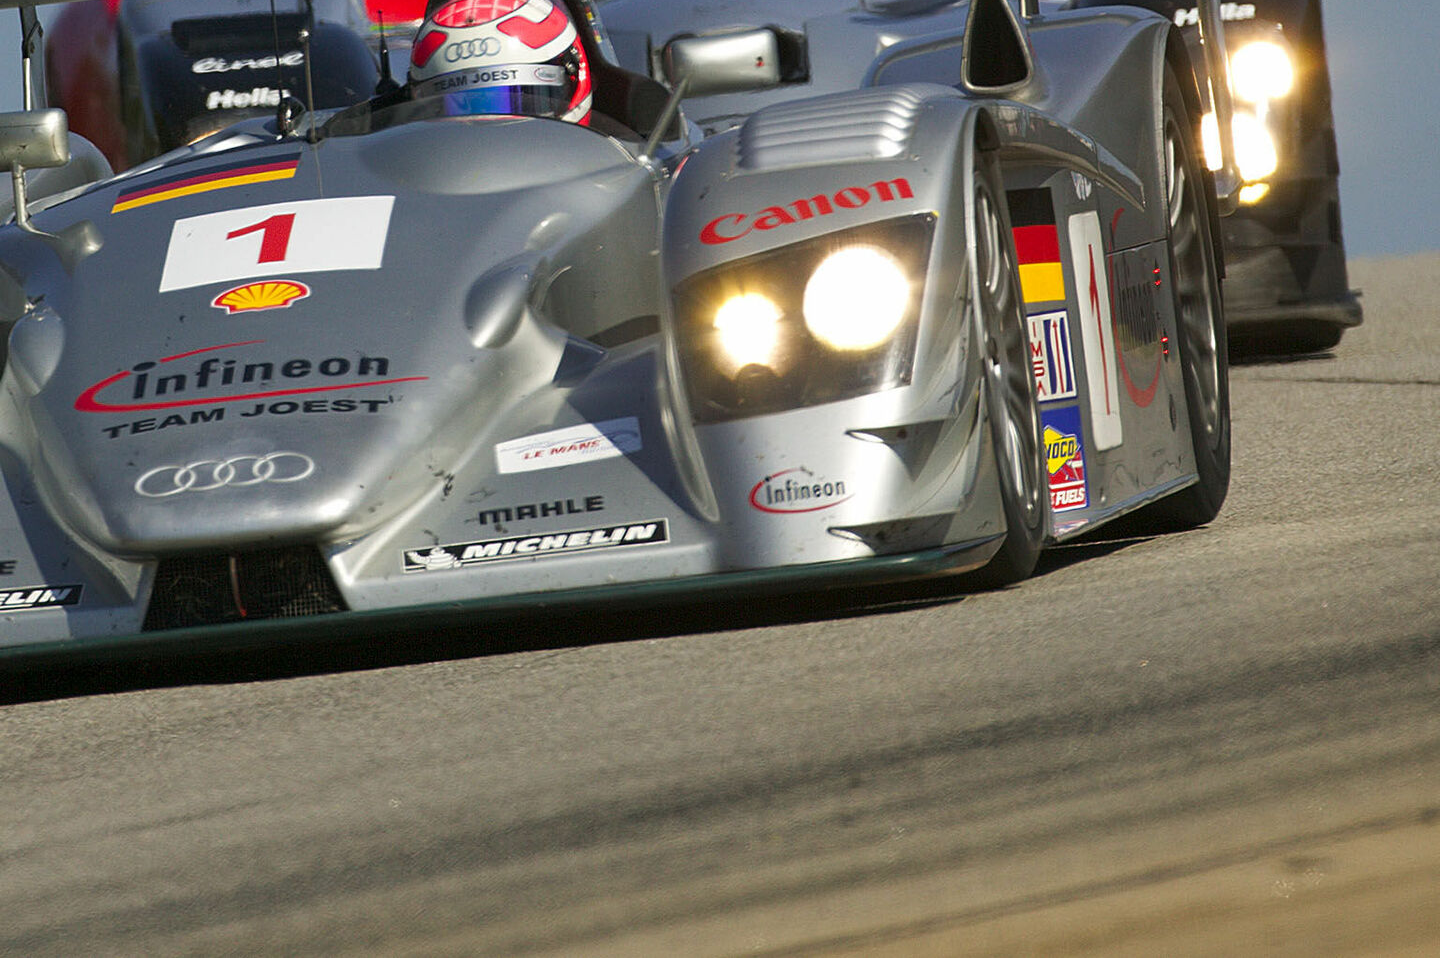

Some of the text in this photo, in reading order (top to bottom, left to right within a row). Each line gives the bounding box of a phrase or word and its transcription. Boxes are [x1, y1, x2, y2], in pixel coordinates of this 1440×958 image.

[433, 69, 519, 91] TEAM JOEST
[698, 177, 915, 246] Canon
[225, 212, 297, 265] 1
[102, 399, 388, 440] TEAM JOEST
[523, 450, 544, 461] LE
[549, 439, 601, 456] MANS
[479, 495, 605, 525] MAHLE
[1055, 486, 1085, 507] FUELS
[460, 523, 658, 560] MICHELIN
